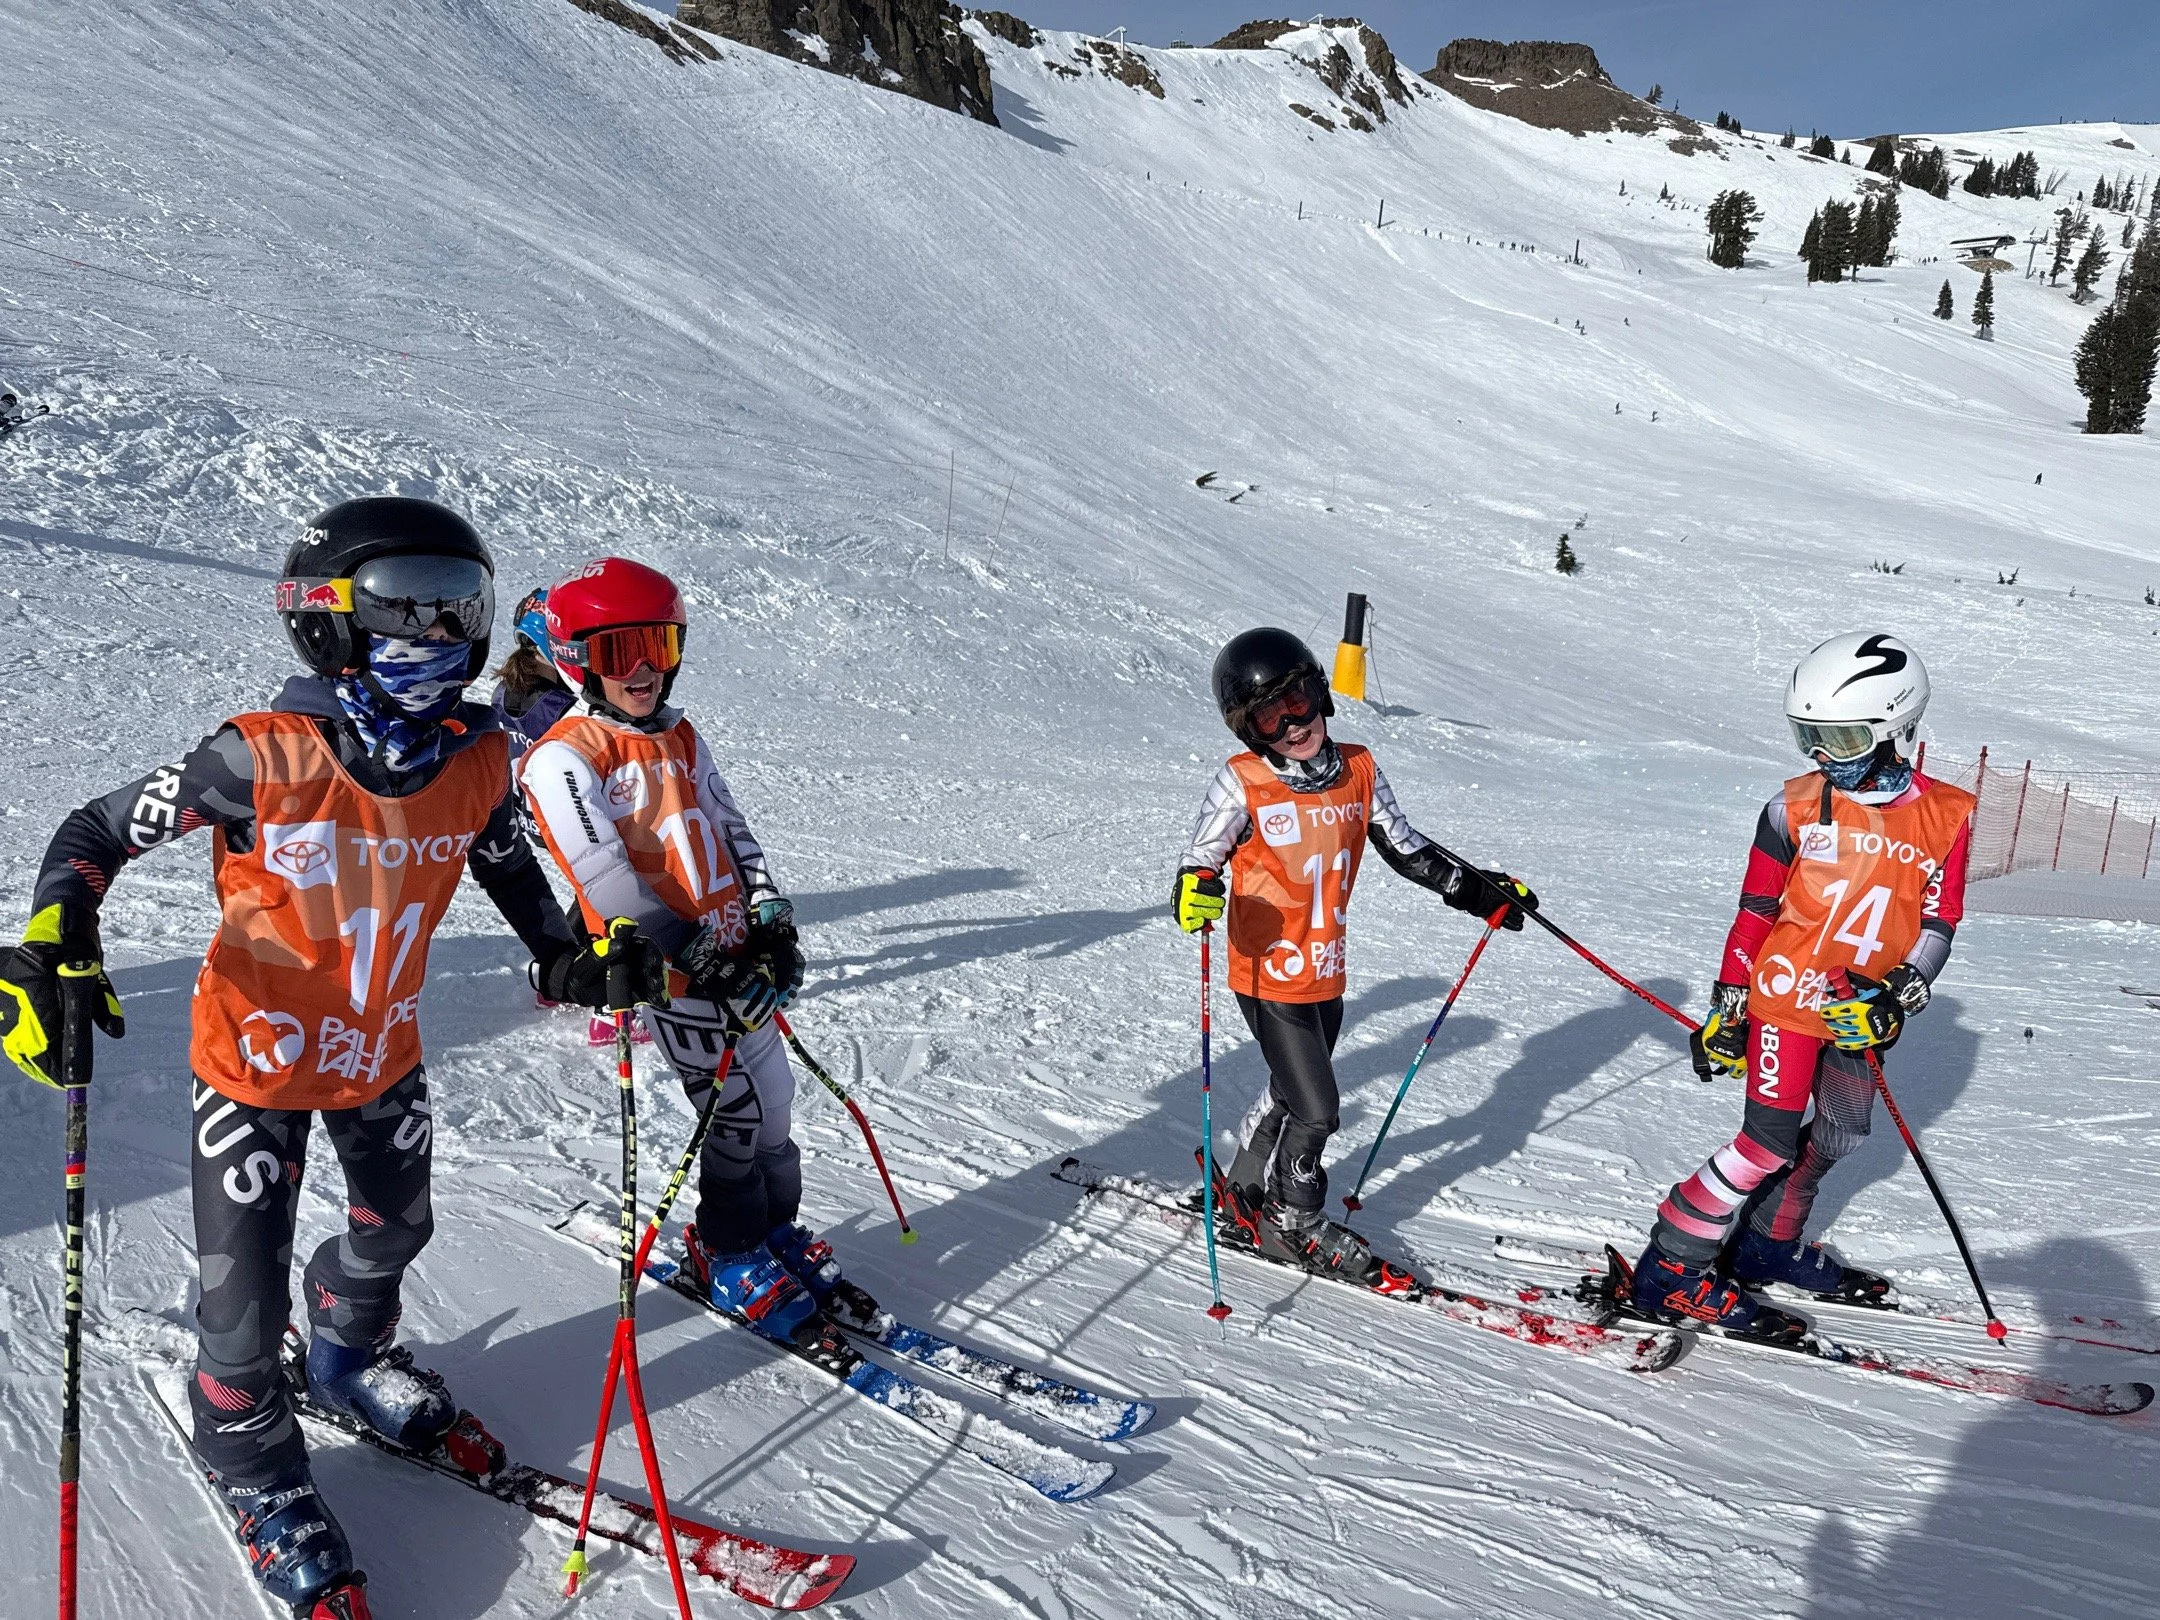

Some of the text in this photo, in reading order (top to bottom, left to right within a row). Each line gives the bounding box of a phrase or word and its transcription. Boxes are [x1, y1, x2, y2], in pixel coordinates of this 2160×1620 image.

[549, 639, 578, 660] SMITH
[656, 807, 735, 901] 12
[1302, 847, 1351, 930] 13
[339, 901, 426, 1017] 11
[1807, 878, 1893, 967] 14
[1713, 1045, 1737, 1058] LEVEL
[659, 1151, 696, 1211] LEKI
[65, 1223, 84, 1311] LEKI
[620, 1191, 634, 1263] LEKI
